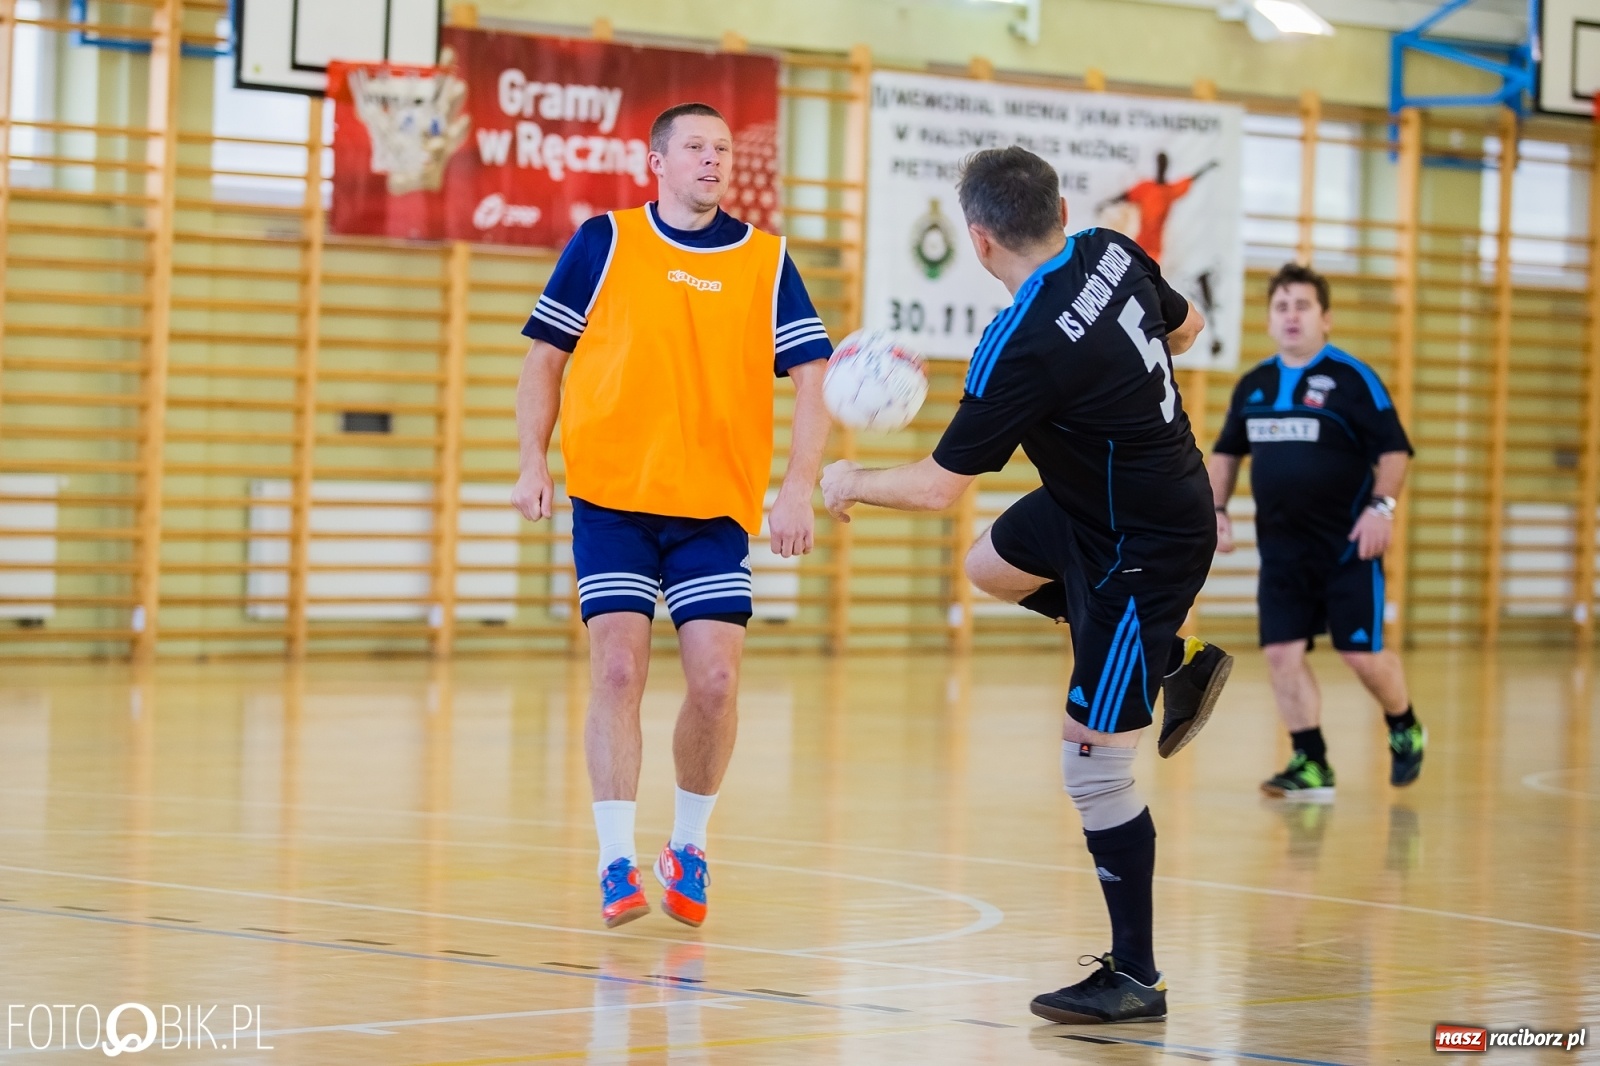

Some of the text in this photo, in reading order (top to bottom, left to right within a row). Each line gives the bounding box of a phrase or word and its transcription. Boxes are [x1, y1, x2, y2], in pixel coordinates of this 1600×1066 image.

[498, 68, 622, 134] Gramy
[475, 120, 650, 187] w Ręczną
[1055, 311, 1086, 342] KS
[1071, 272, 1113, 326] NAPRZÓD
[1116, 294, 1176, 424] 5
